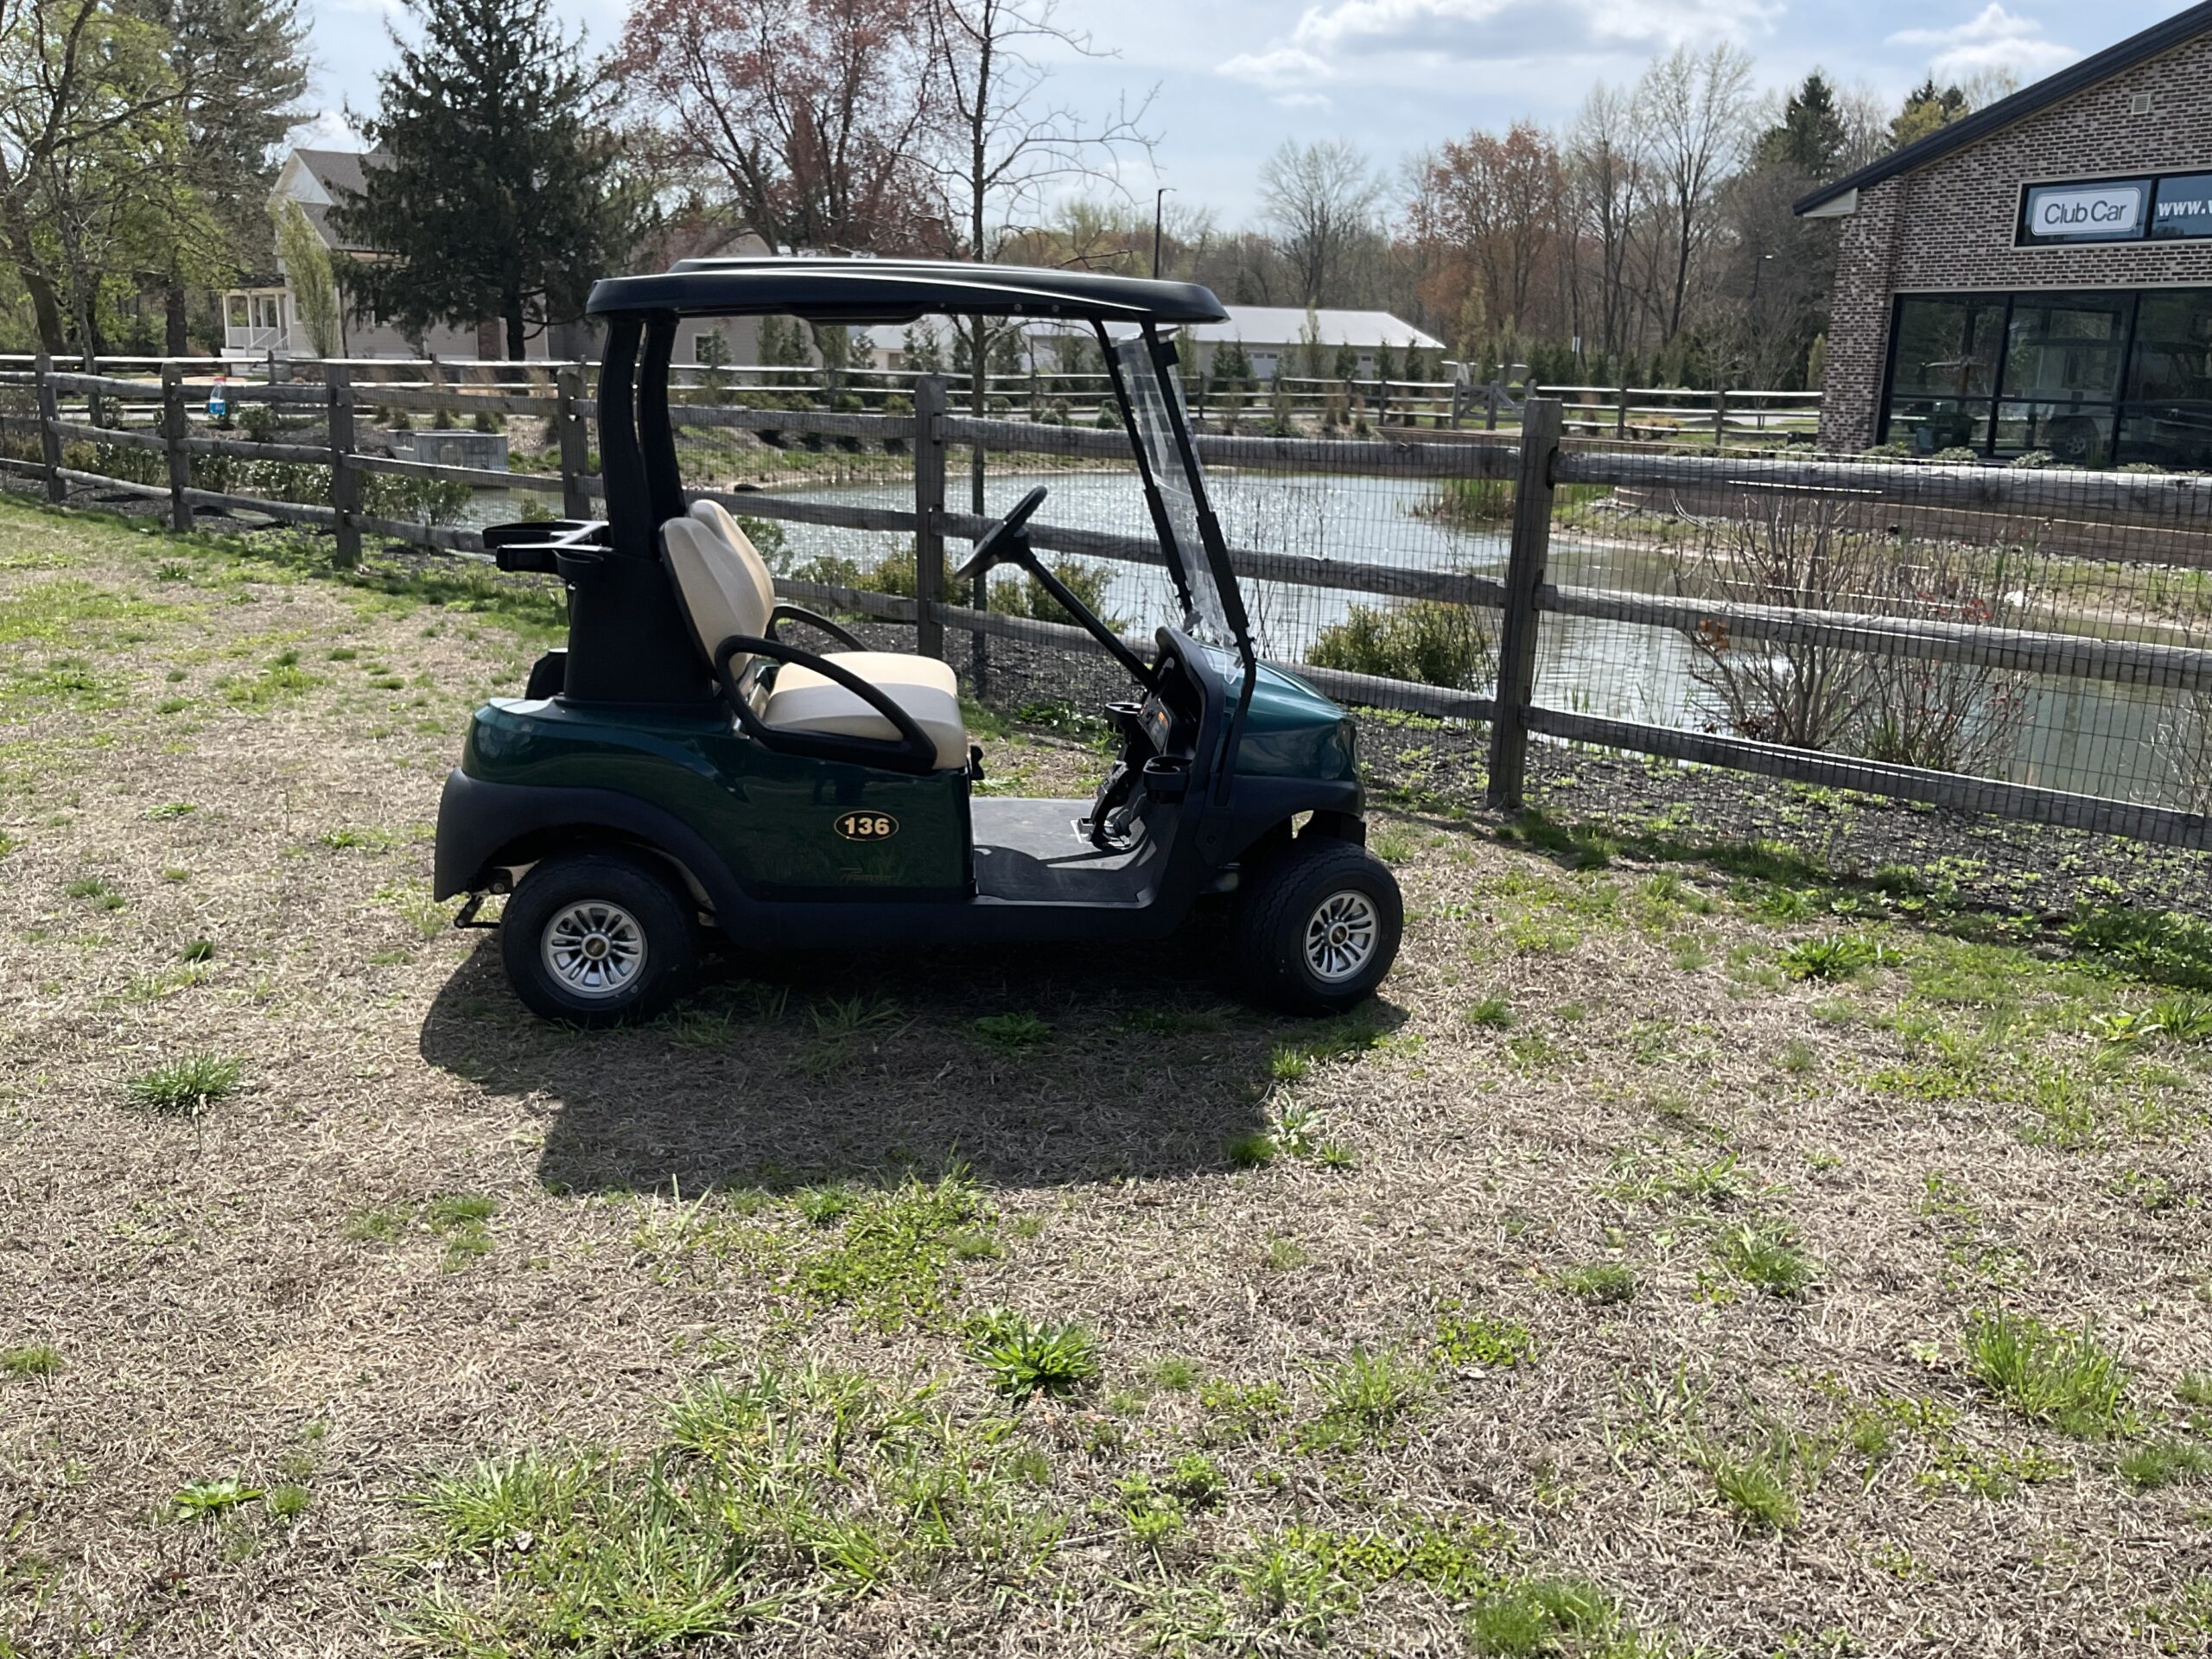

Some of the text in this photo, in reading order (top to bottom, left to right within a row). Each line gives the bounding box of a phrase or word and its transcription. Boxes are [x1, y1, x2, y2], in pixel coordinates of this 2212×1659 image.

[2044, 200, 2127, 225] Club Car
[844, 817, 890, 836] 136
